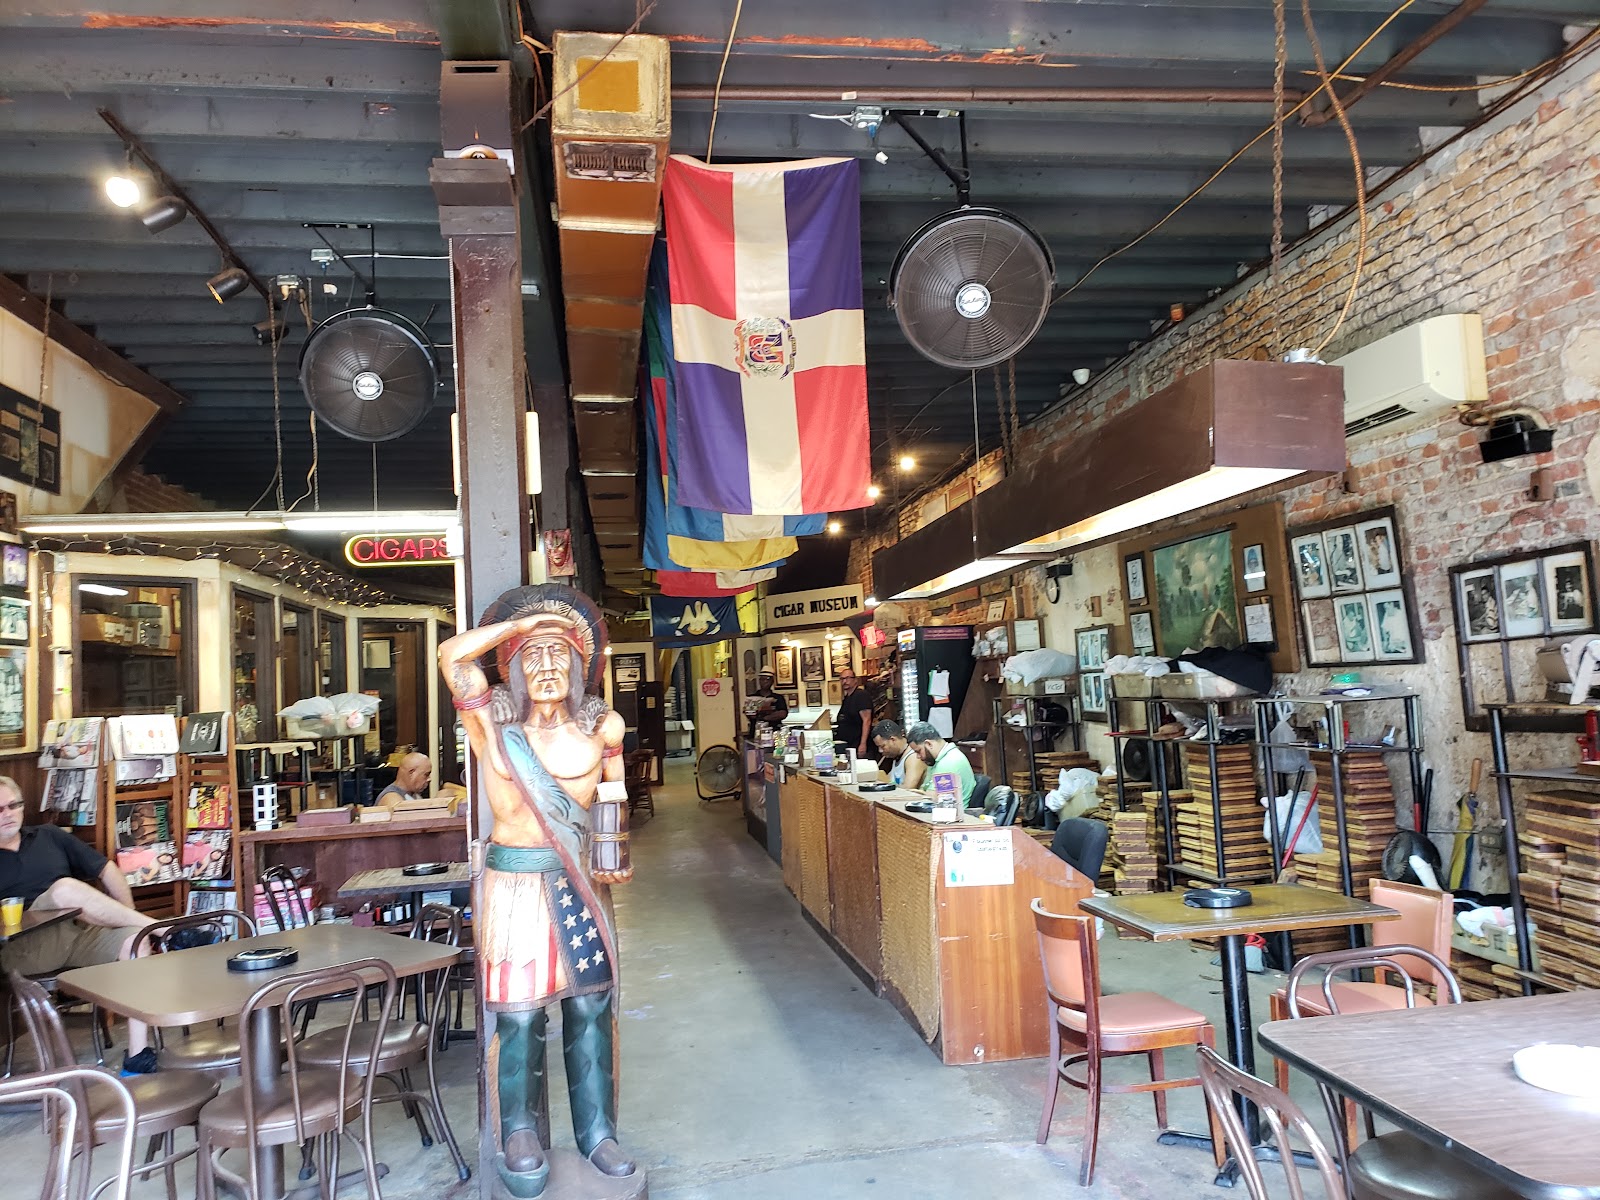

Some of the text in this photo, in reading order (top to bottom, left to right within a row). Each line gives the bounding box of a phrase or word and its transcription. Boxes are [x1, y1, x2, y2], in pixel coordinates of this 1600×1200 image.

[353, 538, 452, 561] CIGARS
[774, 595, 858, 619] CIGAR MUSEUM
